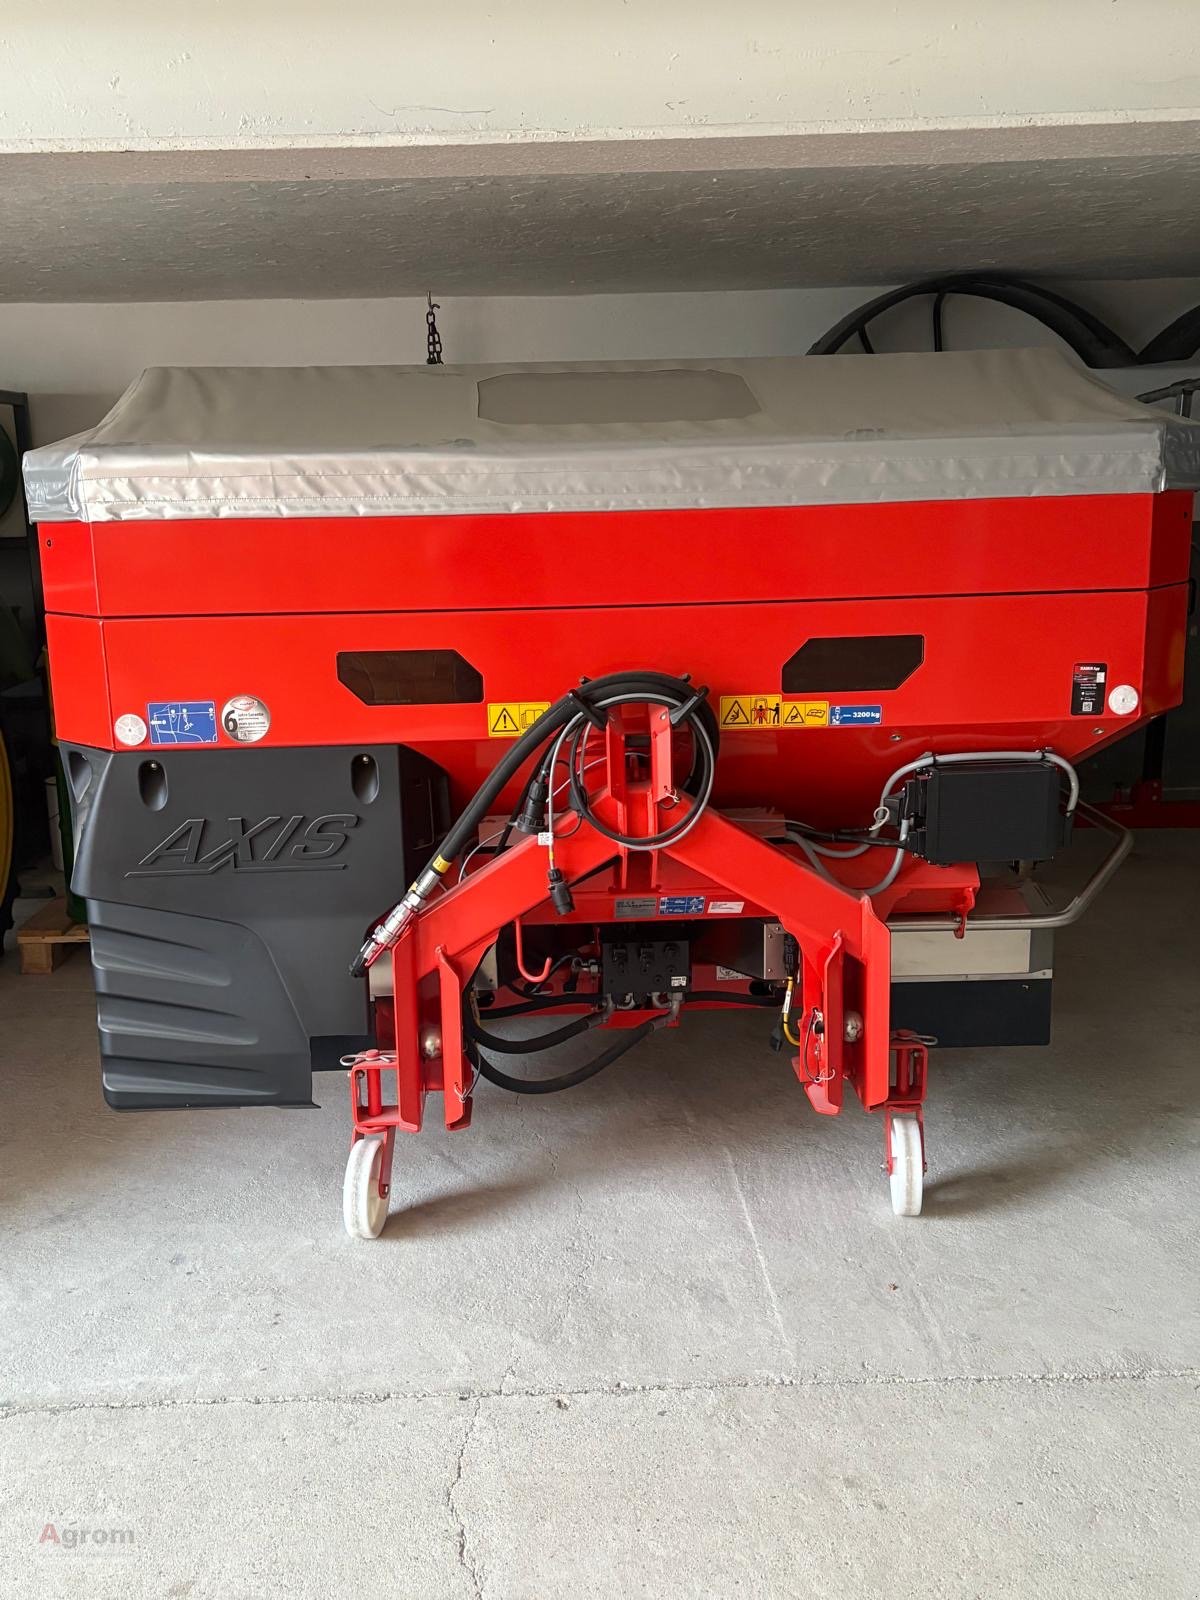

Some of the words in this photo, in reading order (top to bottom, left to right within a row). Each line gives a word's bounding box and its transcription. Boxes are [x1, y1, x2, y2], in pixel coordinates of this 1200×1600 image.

[224, 709, 238, 732] 6
[871, 711, 880, 719] kg
[138, 813, 360, 865] AXIS
